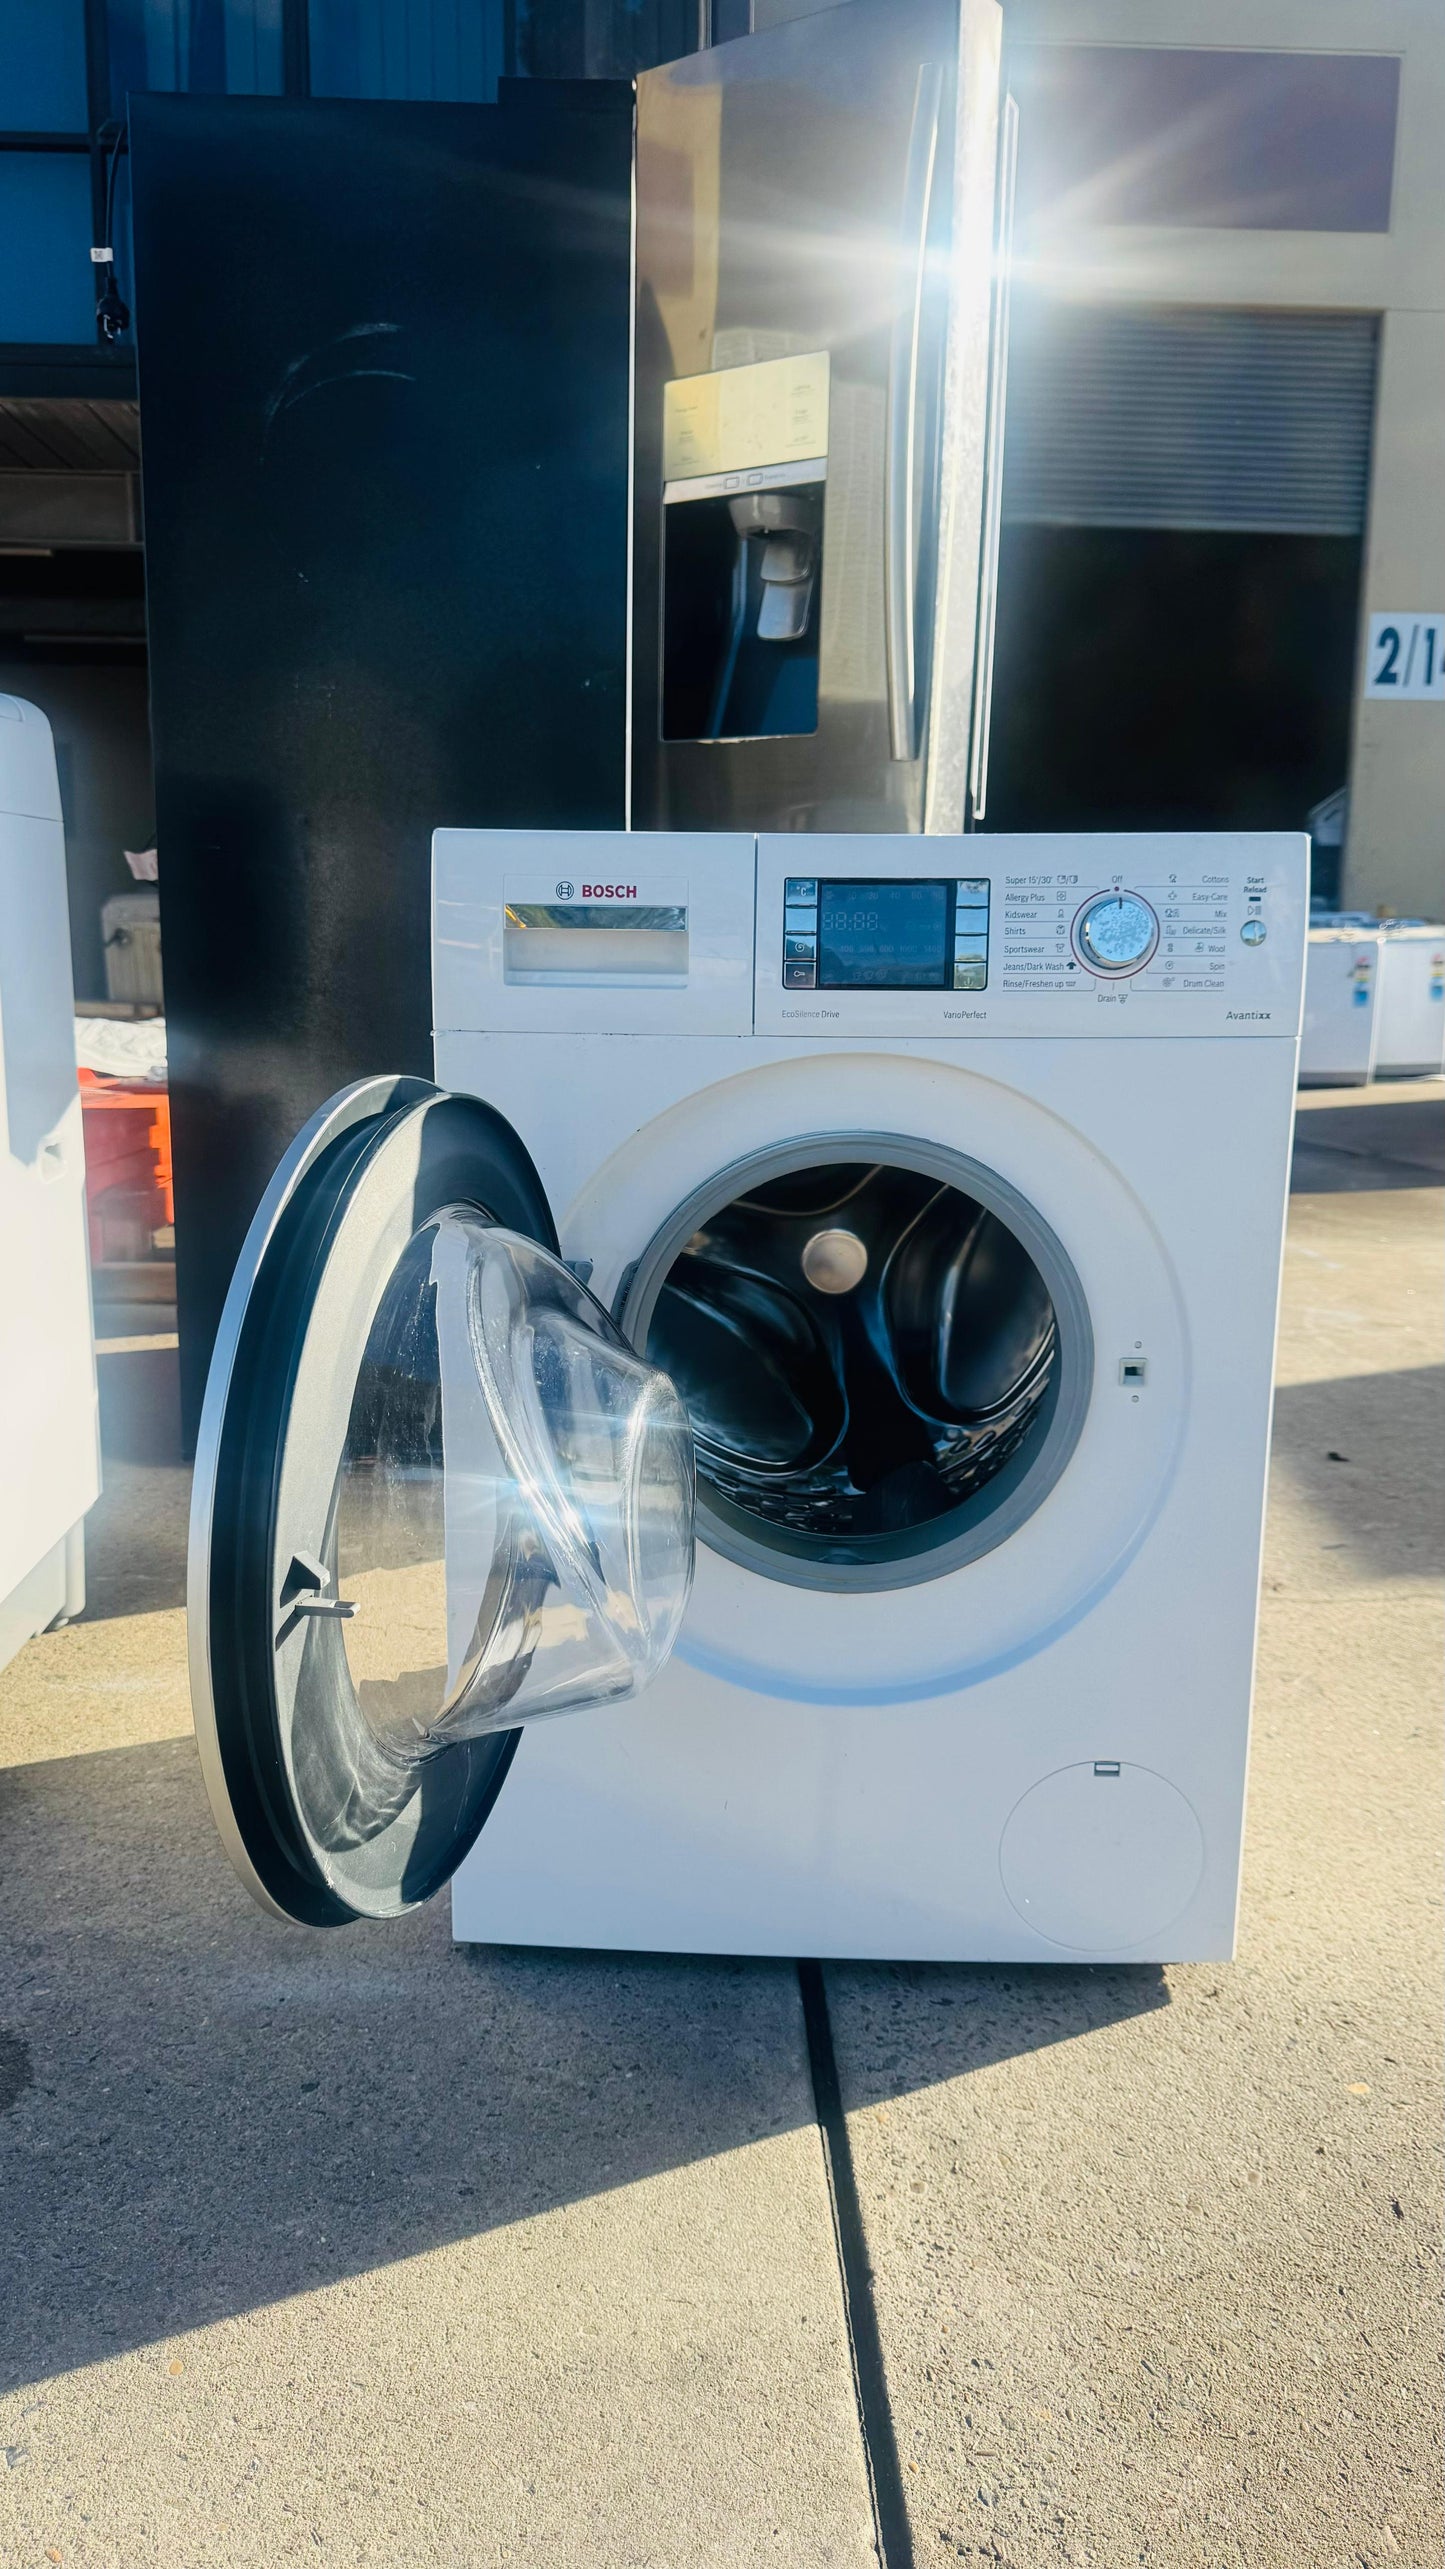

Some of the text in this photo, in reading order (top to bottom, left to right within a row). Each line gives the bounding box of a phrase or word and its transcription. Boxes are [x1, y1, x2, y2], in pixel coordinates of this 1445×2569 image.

[1375, 625, 1445, 688] 2/1
[1005, 875, 1027, 885] Super
[1111, 875, 1123, 884] Off
[1202, 875, 1230, 884] Cottons
[1247, 876, 1265, 885] Start
[582, 885, 637, 898] BOSCH
[1243, 886, 1267, 894] Reload
[1005, 893, 1046, 903] Allergy Plus
[1004, 910, 1038, 919] Kidswear
[1214, 910, 1227, 919] Mix
[1004, 926, 1026, 935] Shirts
[1182, 926, 1227, 935] Delicate/Silk
[1004, 945, 1045, 954] Sportswear
[1207, 944, 1226, 953] Wool
[1003, 962, 1065, 971] Jeans/Dark Wash
[1209, 962, 1226, 972] Spin
[1003, 979, 1065, 989] Rinse/Freshen up
[1183, 980, 1225, 988] Drum Clean
[1097, 994, 1117, 1003] Drain
[781, 1010, 840, 1019] EcoSilence Drive
[943, 1010, 987, 1019] VarioPerfect
[1225, 1011, 1272, 1020] Avantixx
